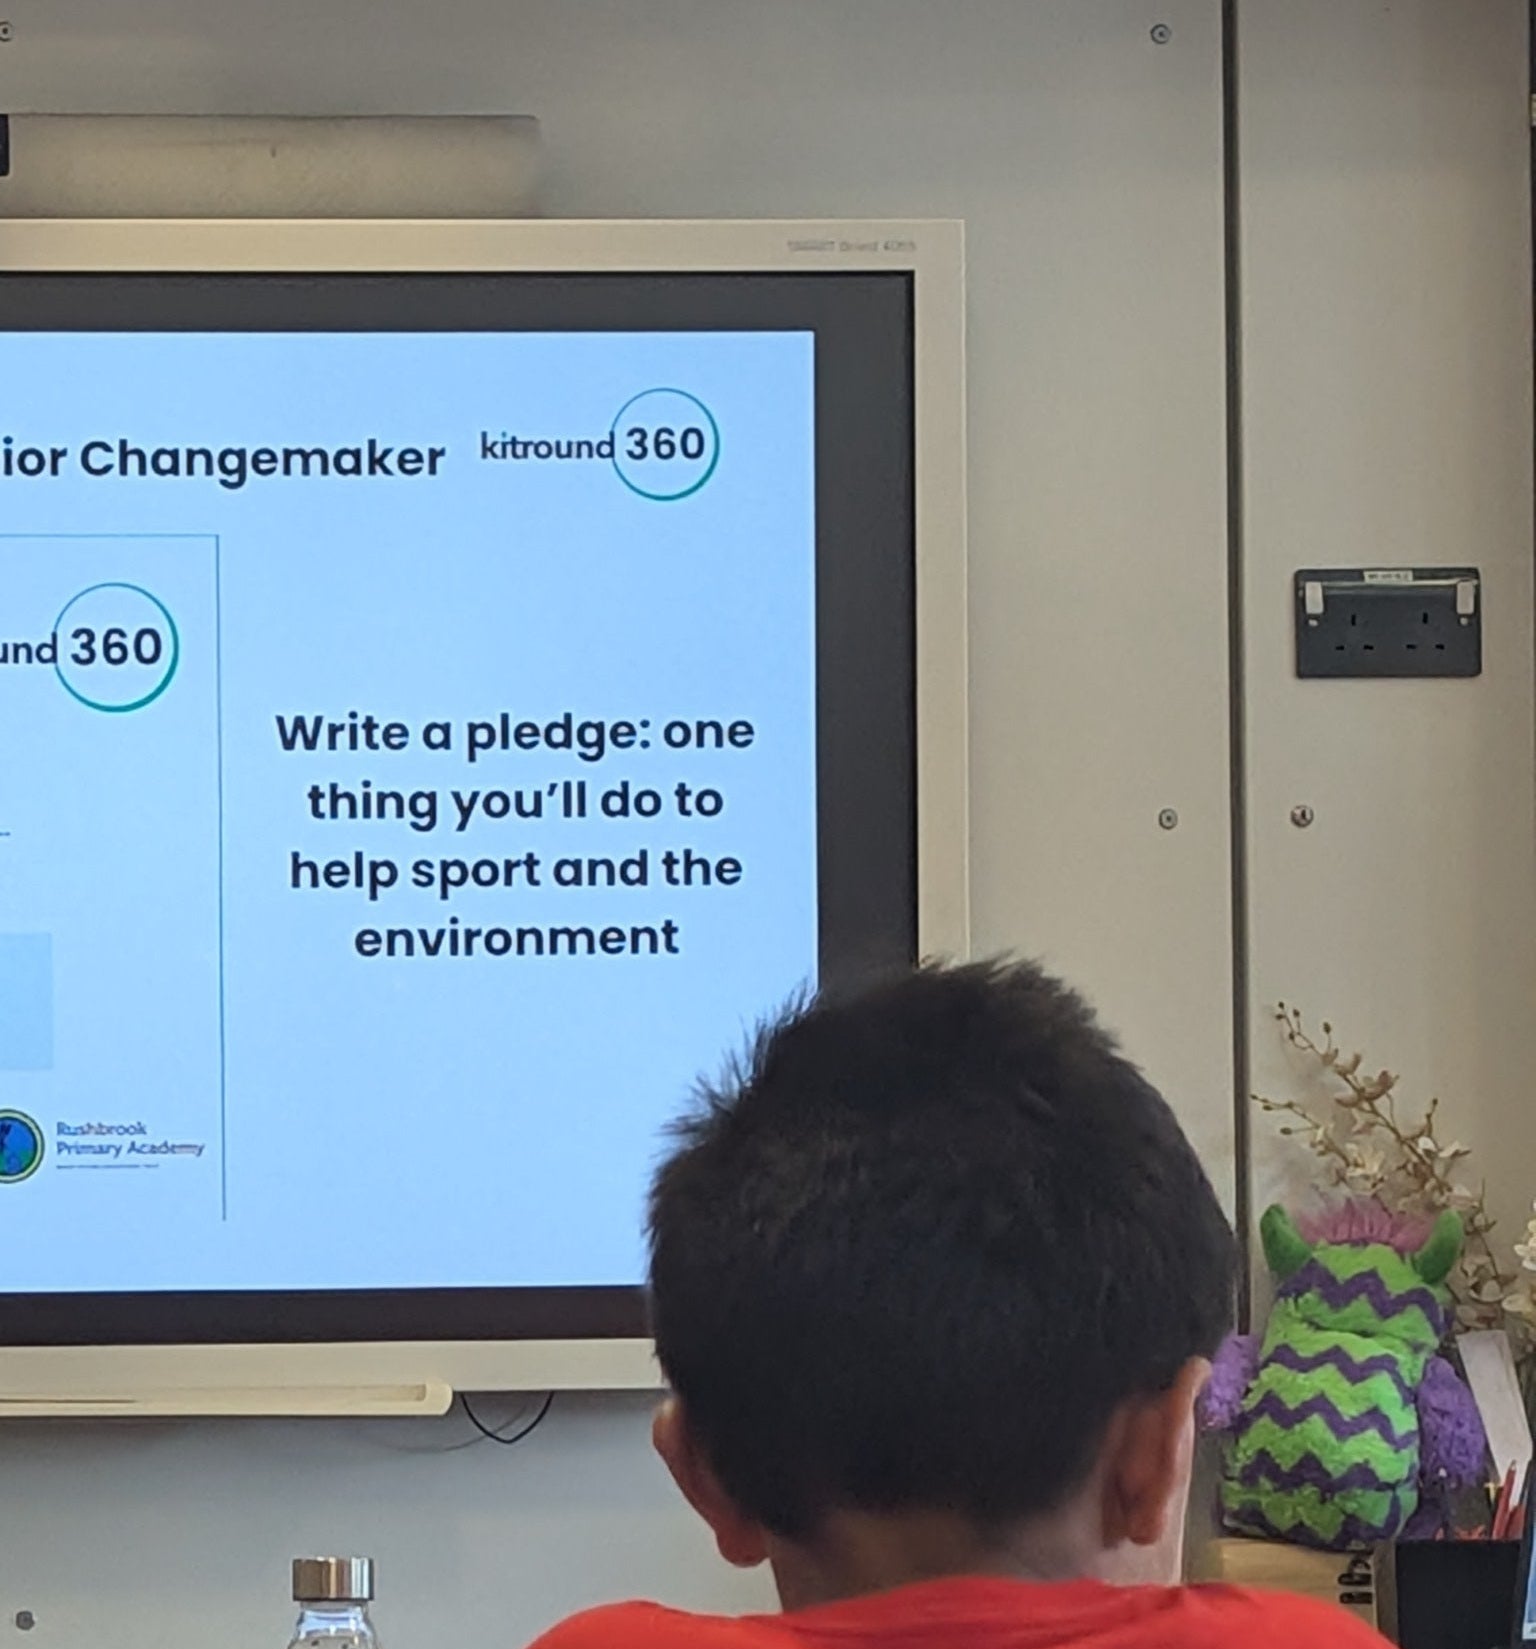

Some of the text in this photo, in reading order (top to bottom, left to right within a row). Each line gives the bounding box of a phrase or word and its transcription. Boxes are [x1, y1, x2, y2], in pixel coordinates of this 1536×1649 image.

[81, 439, 446, 489] Changemaker
[480, 427, 704, 460] kitround 360
[71, 628, 162, 665] 360
[275, 711, 754, 763] Write a pledge: one
[308, 780, 723, 832] thing you’ll do to
[291, 849, 742, 901] help sport and the
[355, 916, 679, 957] environment
[56, 1140, 205, 1158] Primary Academy
[57, 1121, 147, 1136] Rushbrook
